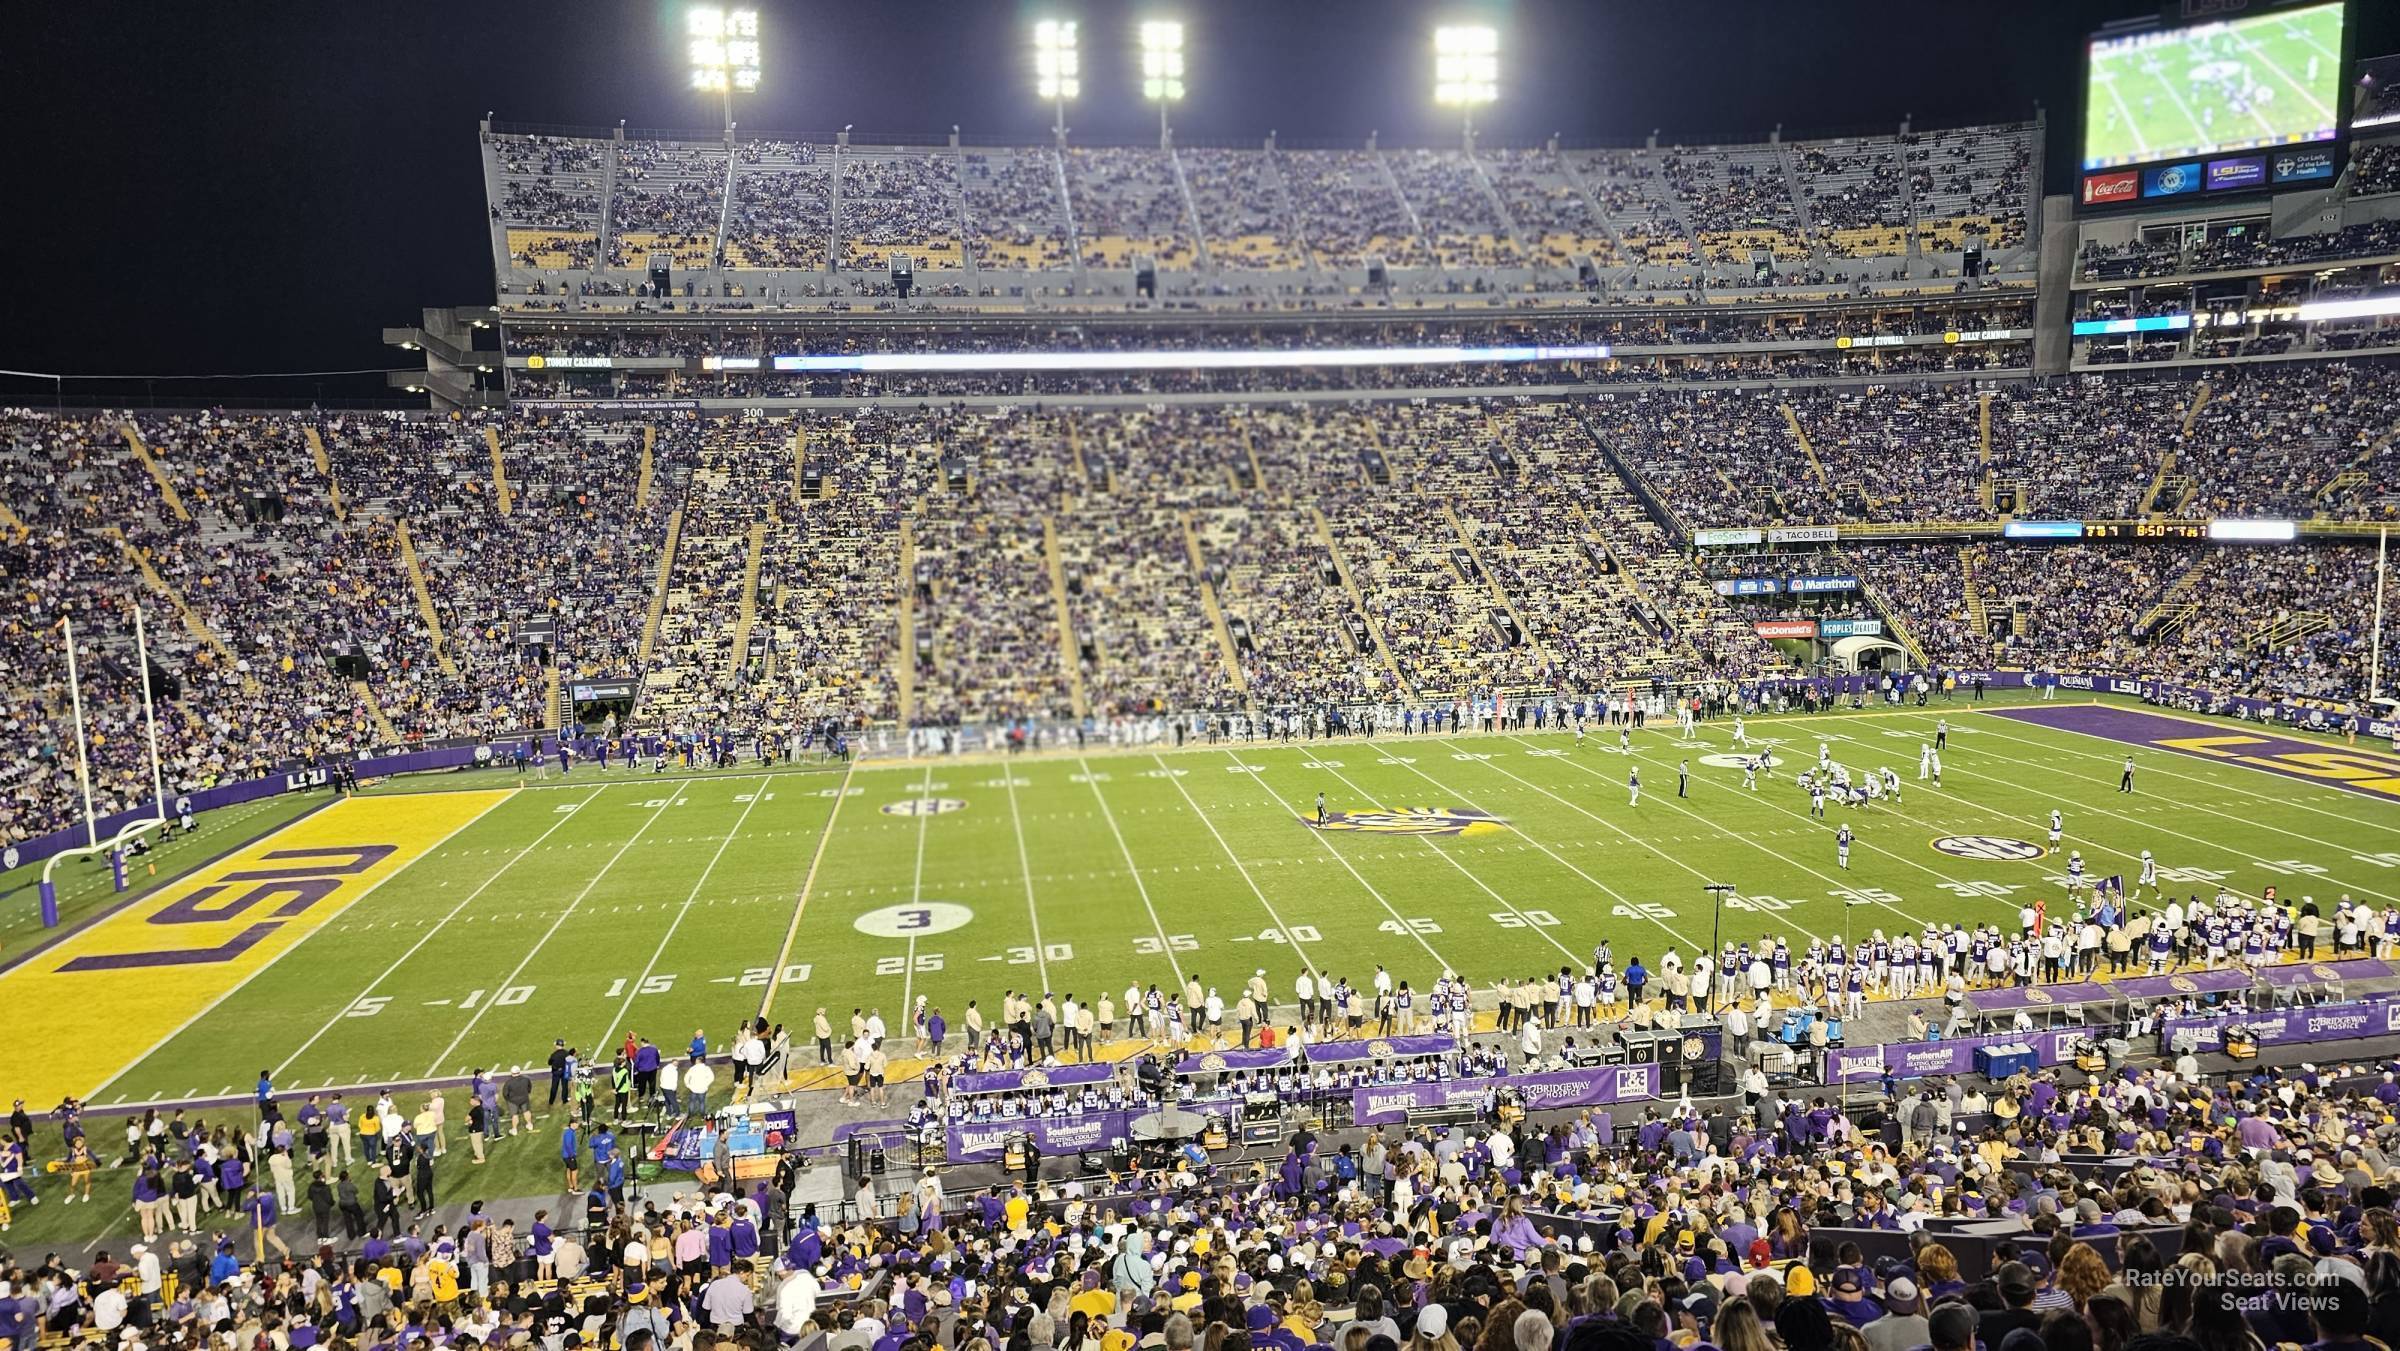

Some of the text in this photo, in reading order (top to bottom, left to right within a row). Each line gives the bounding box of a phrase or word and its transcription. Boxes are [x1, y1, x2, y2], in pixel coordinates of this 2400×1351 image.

[1853, 338, 1873, 347] JERRY
[1875, 336, 1905, 346] STOVALL
[1960, 331, 1981, 341] BILLY
[1982, 330, 2011, 340] CANNON
[545, 358, 572, 368] TOMMY
[574, 357, 612, 368] CASANOVA
[742, 408, 763, 418] 300
[1786, 530, 1834, 539] TACO BELL
[1805, 578, 1856, 590] Marathon
[1758, 625, 1812, 636] McDonald's
[1823, 624, 1852, 634] PEOPLES
[2110, 680, 2141, 694] LSU
[2149, 736, 2400, 795] LS
[1938, 837, 2038, 860] SEC
[2253, 860, 2328, 875] 15
[1936, 880, 2013, 897] 30
[2266, 888, 2274, 898] 2
[1725, 895, 1792, 912] 40
[1827, 888, 1903, 905] 35
[54, 843, 400, 974] LSU
[1611, 902, 1677, 919] 45
[897, 911, 932, 929] 3
[1489, 910, 1562, 928] 50
[1378, 918, 1443, 935] 45
[1258, 926, 1323, 944] 40
[1132, 934, 1200, 954] 35
[1007, 943, 1074, 964] 30
[875, 953, 945, 976] 25
[739, 964, 813, 987] 20
[605, 974, 677, 997] 15
[459, 985, 536, 1009] 10
[346, 996, 393, 1018] 5
[2320, 1015, 2368, 1026] BRIDGEWAY
[1907, 1048, 1953, 1061] SouthernAIR
[1464, 1059, 1472, 1072] 3
[1378, 1070, 1386, 1081] 6
[1620, 1070, 1645, 1088] H&E
[1259, 1079, 1267, 1091] 2
[1536, 1081, 1590, 1094] BRIDGEWAY
[1546, 1089, 1581, 1099] HOSPICE
[978, 1103, 991, 1115] 72
[1002, 1105, 1015, 1117] 69
[1046, 1122, 1101, 1136] SouthernAIR
[1062, 1138, 1092, 1147] PLUMBING
[1075, 1132, 1102, 1142] COOLING
[1468, 1157, 1474, 1171] 1
[436, 1276, 442, 1289] 4
